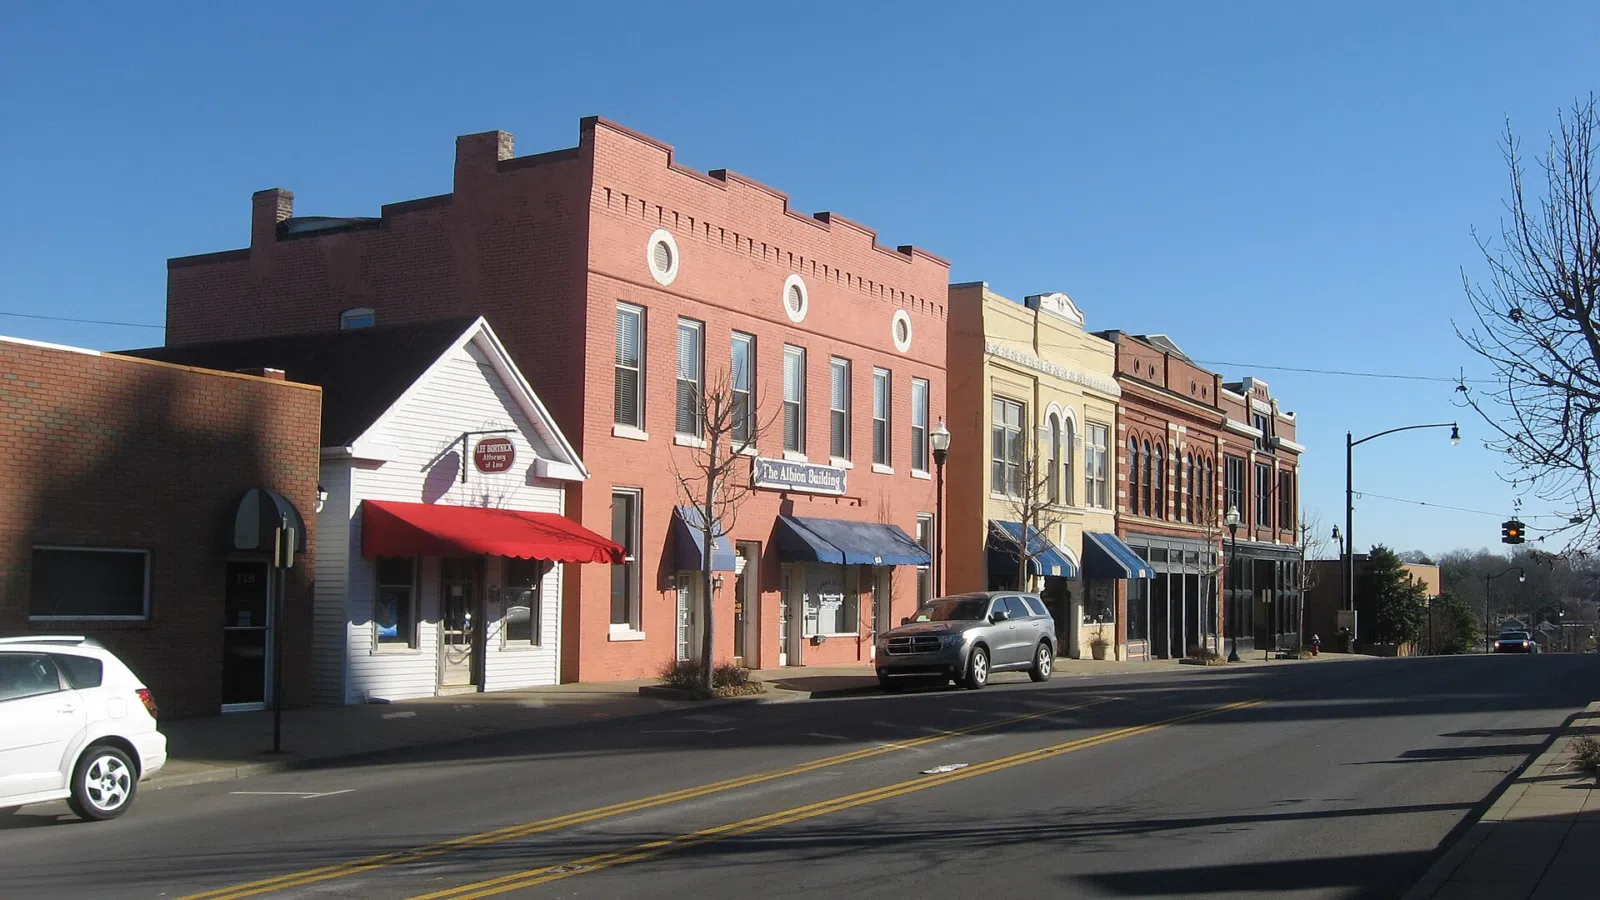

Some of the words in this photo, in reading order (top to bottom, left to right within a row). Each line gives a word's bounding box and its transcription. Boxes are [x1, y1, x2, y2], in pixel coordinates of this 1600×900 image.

[477, 444, 486, 453] LEE
[482, 454, 506, 462] Attorney
[762, 464, 778, 480] The
[780, 466, 806, 482] Albion
[808, 469, 840, 490] Building
